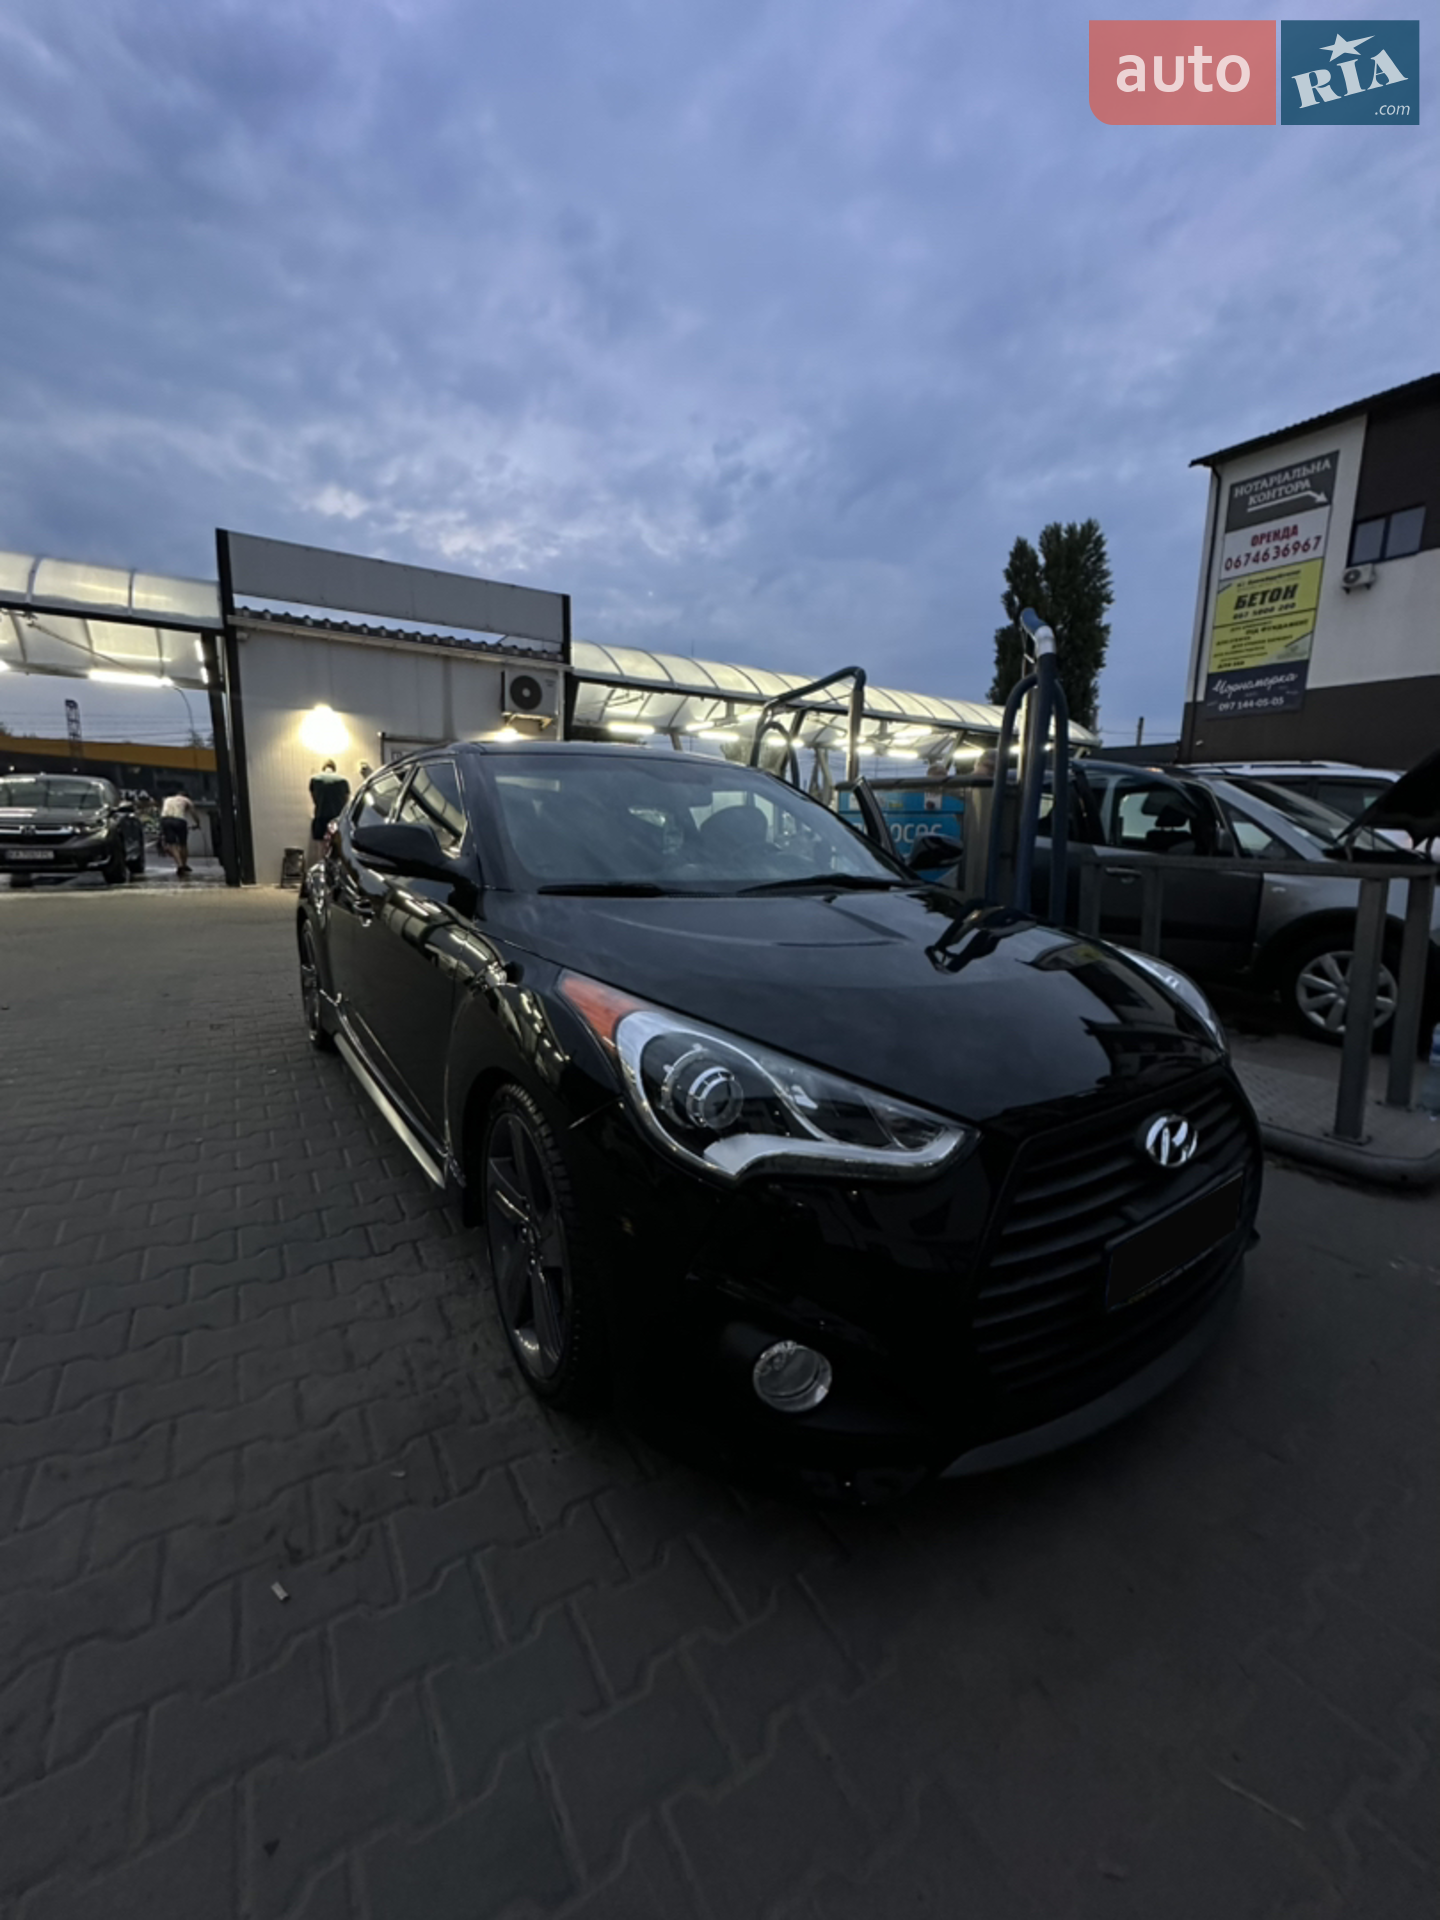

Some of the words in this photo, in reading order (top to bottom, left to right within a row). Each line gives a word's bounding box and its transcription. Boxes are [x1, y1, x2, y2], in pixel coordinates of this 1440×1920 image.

[1233, 458, 1331, 498] НОТАРІАЛЬНА
[1247, 479, 1311, 506] КОНТОРА
[1250, 524, 1299, 547] ОРЕНДА
[1224, 535, 1322, 571] 0674636967
[1234, 583, 1299, 610] БЕТОН
